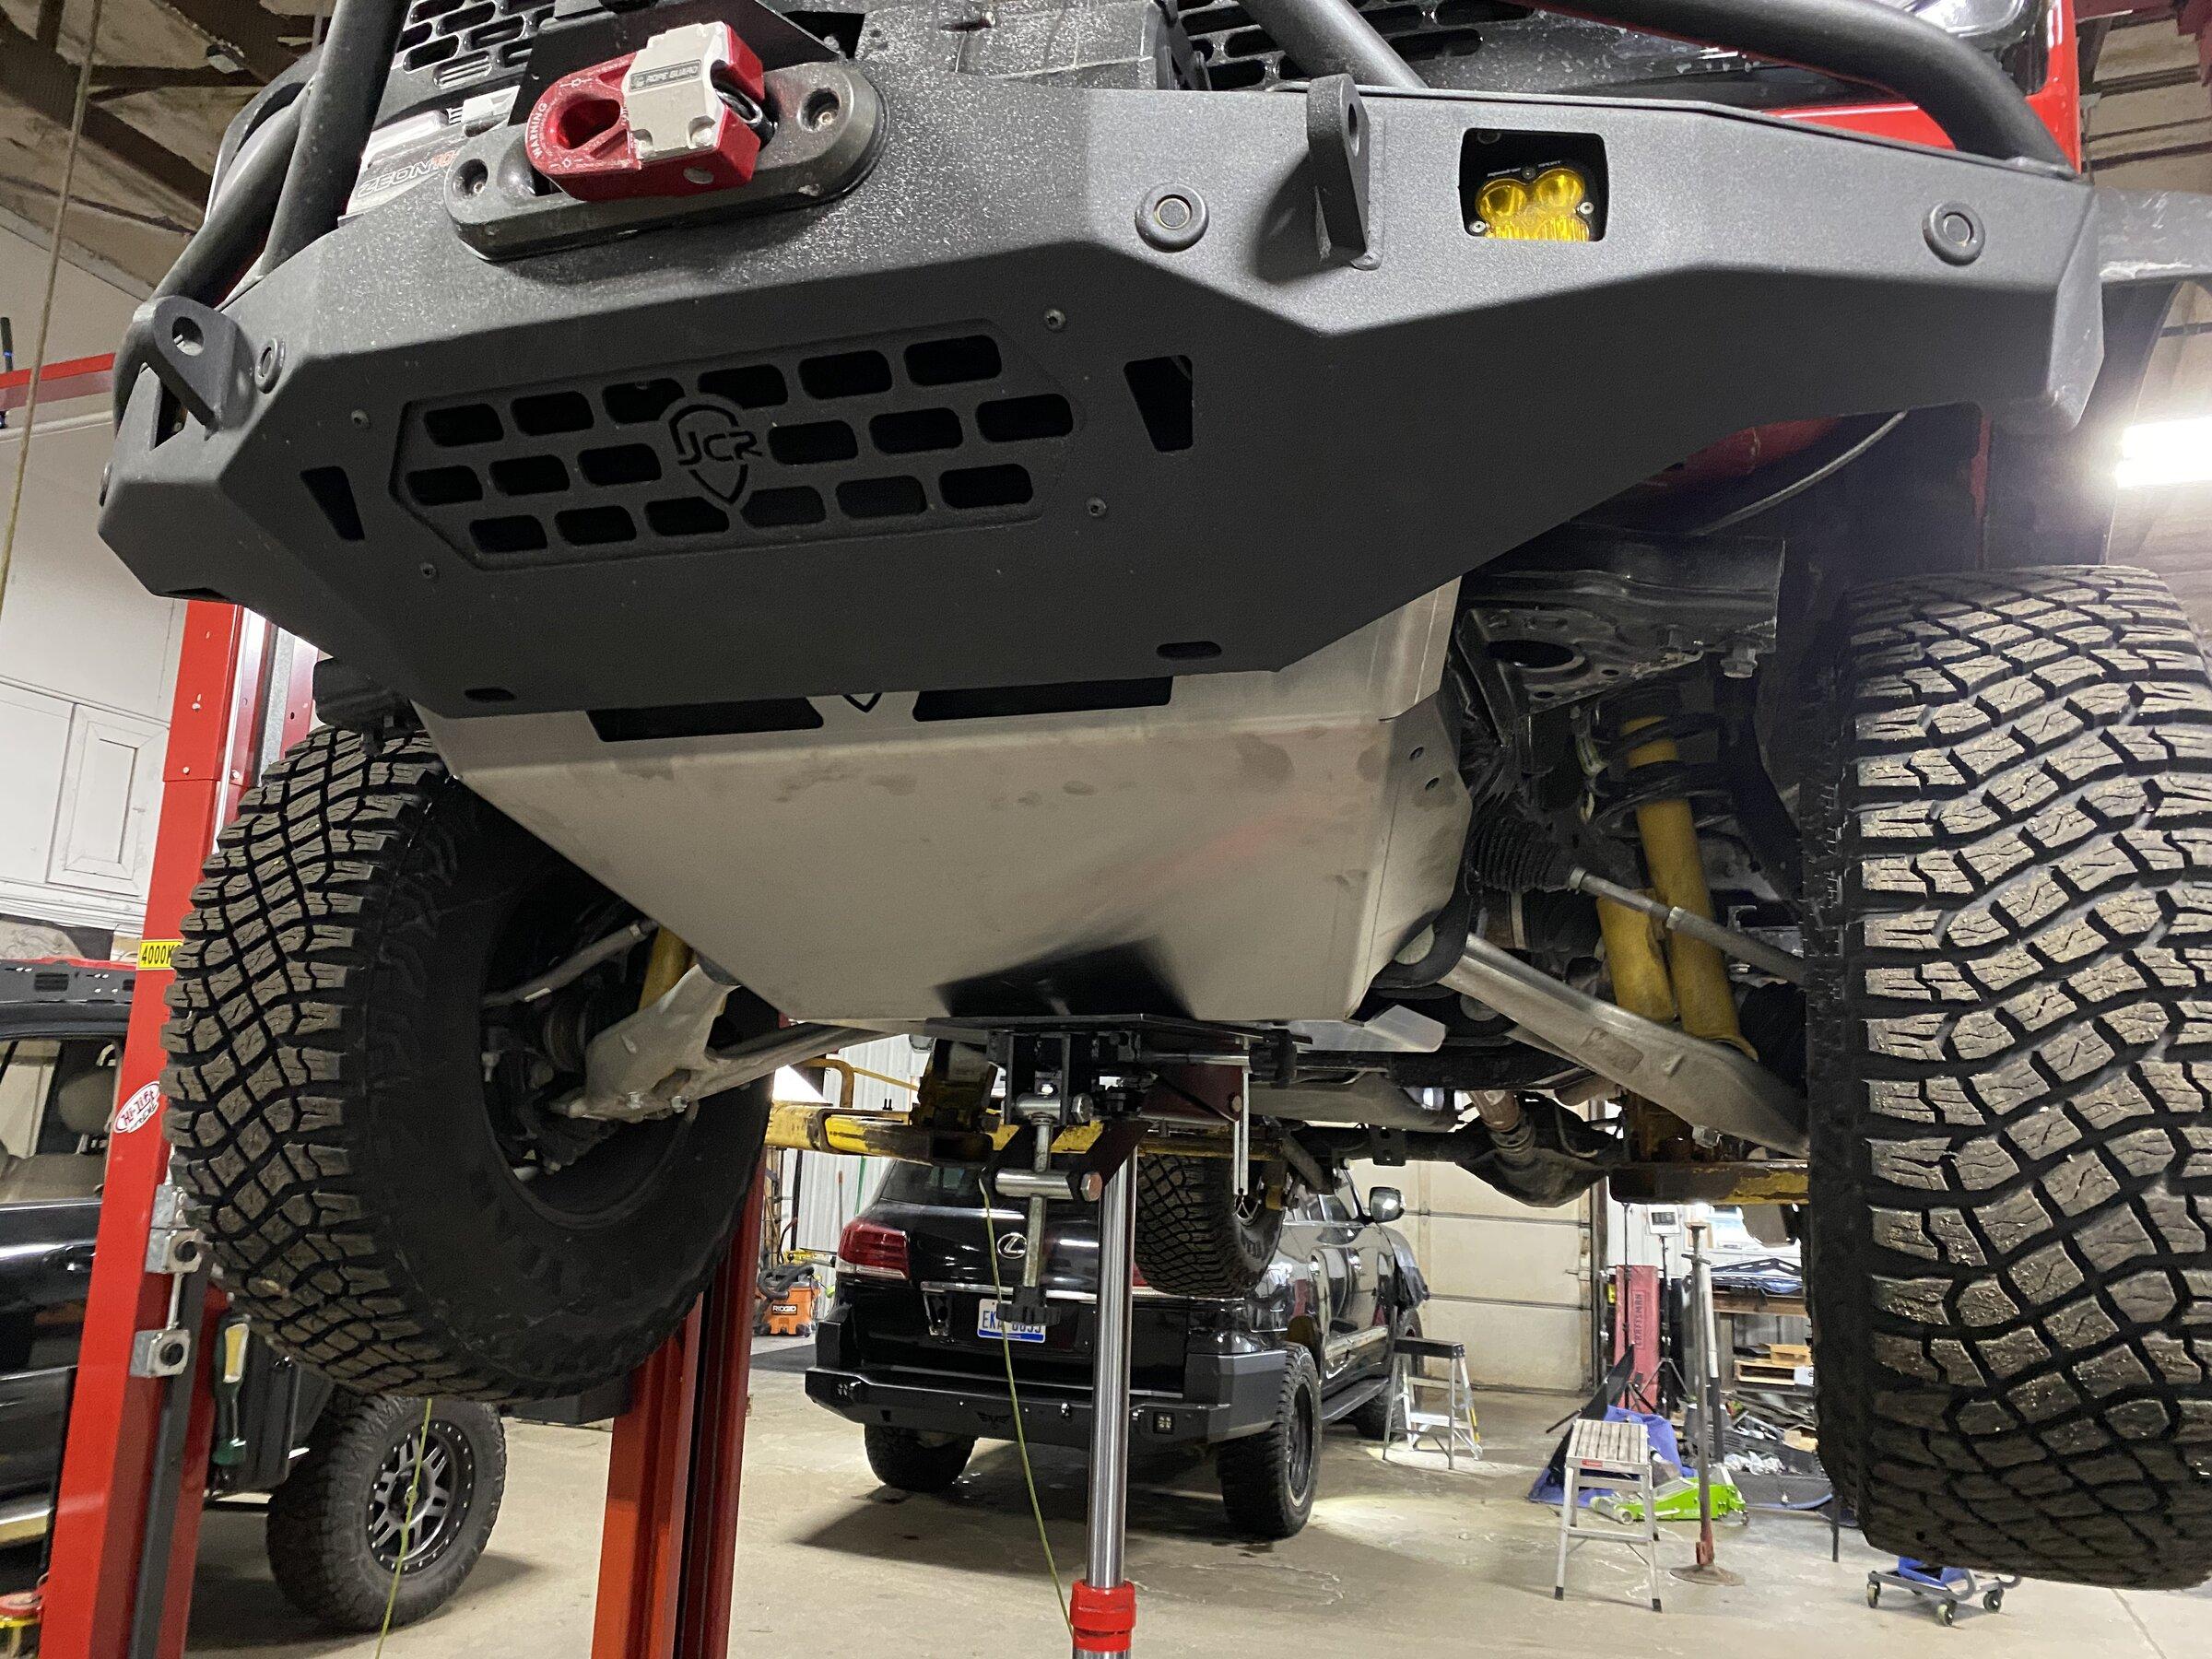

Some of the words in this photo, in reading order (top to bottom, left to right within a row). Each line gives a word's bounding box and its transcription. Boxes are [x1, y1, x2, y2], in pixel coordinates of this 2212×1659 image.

[529, 102, 548, 159] WARNING
[357, 159, 437, 199] ZEON
[677, 430, 763, 466] JCR
[141, 944, 181, 965] 4000K
[1634, 1293, 1643, 1347] CRAFTSMAN
